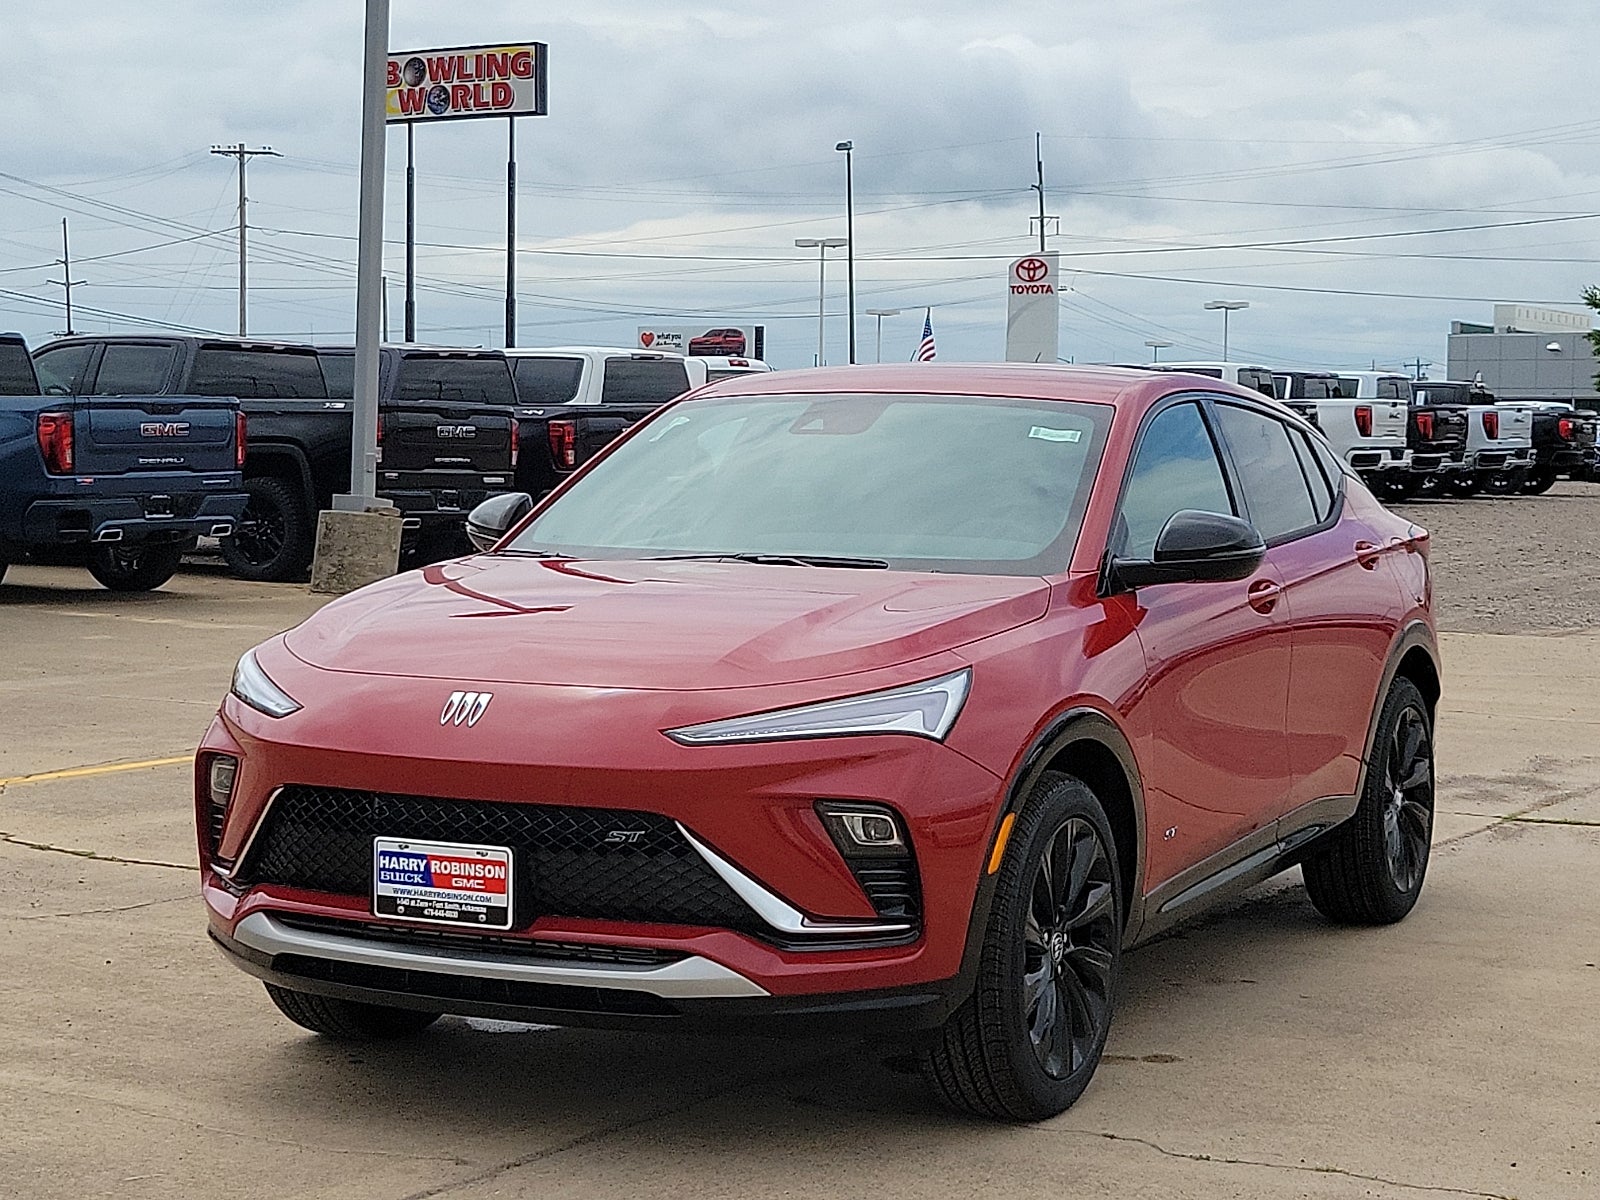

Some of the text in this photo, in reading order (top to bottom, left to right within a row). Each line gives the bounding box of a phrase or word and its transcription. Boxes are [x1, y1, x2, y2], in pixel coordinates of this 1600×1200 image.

[386, 51, 533, 87] BOWLING
[397, 82, 515, 115] WORLD
[1010, 284, 1054, 295] TOYOTA
[657, 331, 671, 339] what
[140, 422, 190, 436] GMC
[436, 425, 477, 438] GMC
[603, 830, 646, 843] ST
[379, 855, 505, 879] HARRY ROBINSON
[380, 871, 486, 889] BUICK GMC
[392, 887, 492, 904] WWW.HARRYROBINSON.COM
